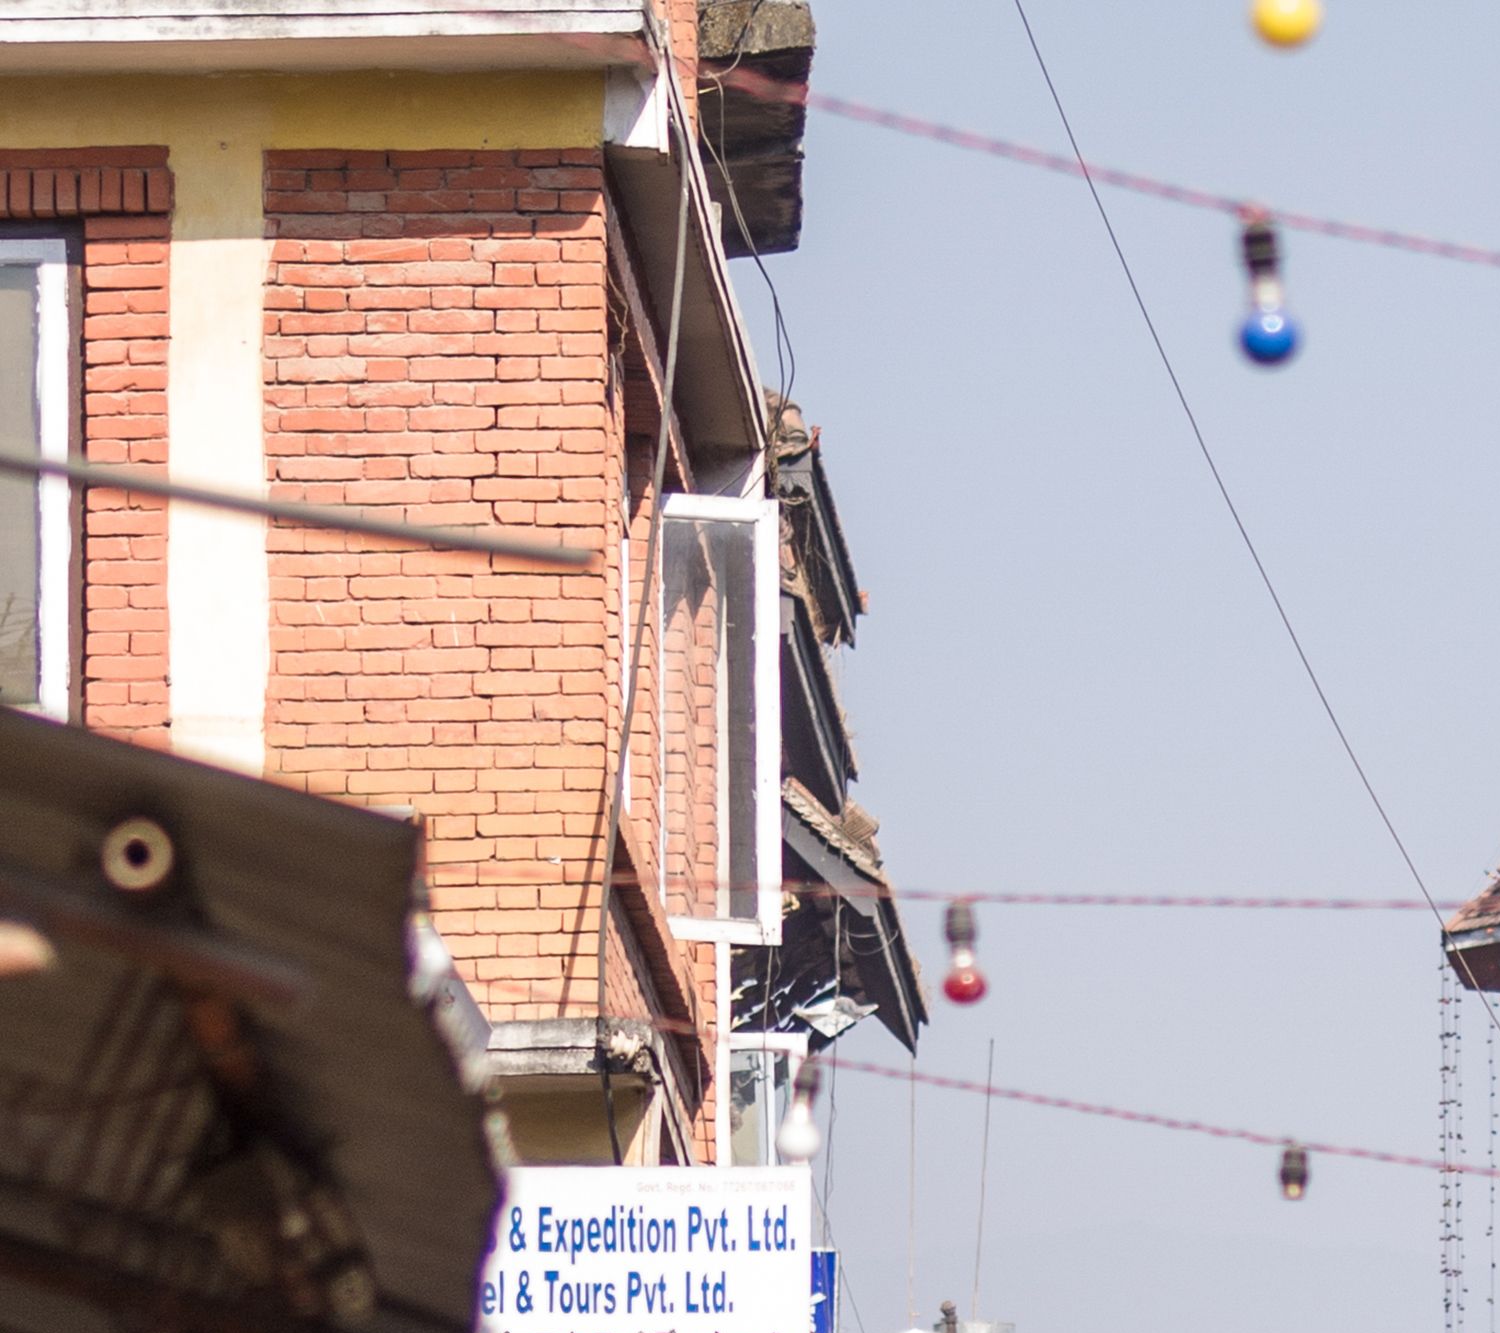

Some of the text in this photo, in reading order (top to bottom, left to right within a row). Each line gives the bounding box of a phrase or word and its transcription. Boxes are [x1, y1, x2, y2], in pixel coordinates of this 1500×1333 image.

[509, 1204, 796, 1264] & Expedition Pvt. Ltd.
[516, 1270, 533, 1314] &
[544, 1270, 616, 1314] Tours
[626, 1271, 675, 1314] Pvt.
[685, 1271, 734, 1314] Ltd.
